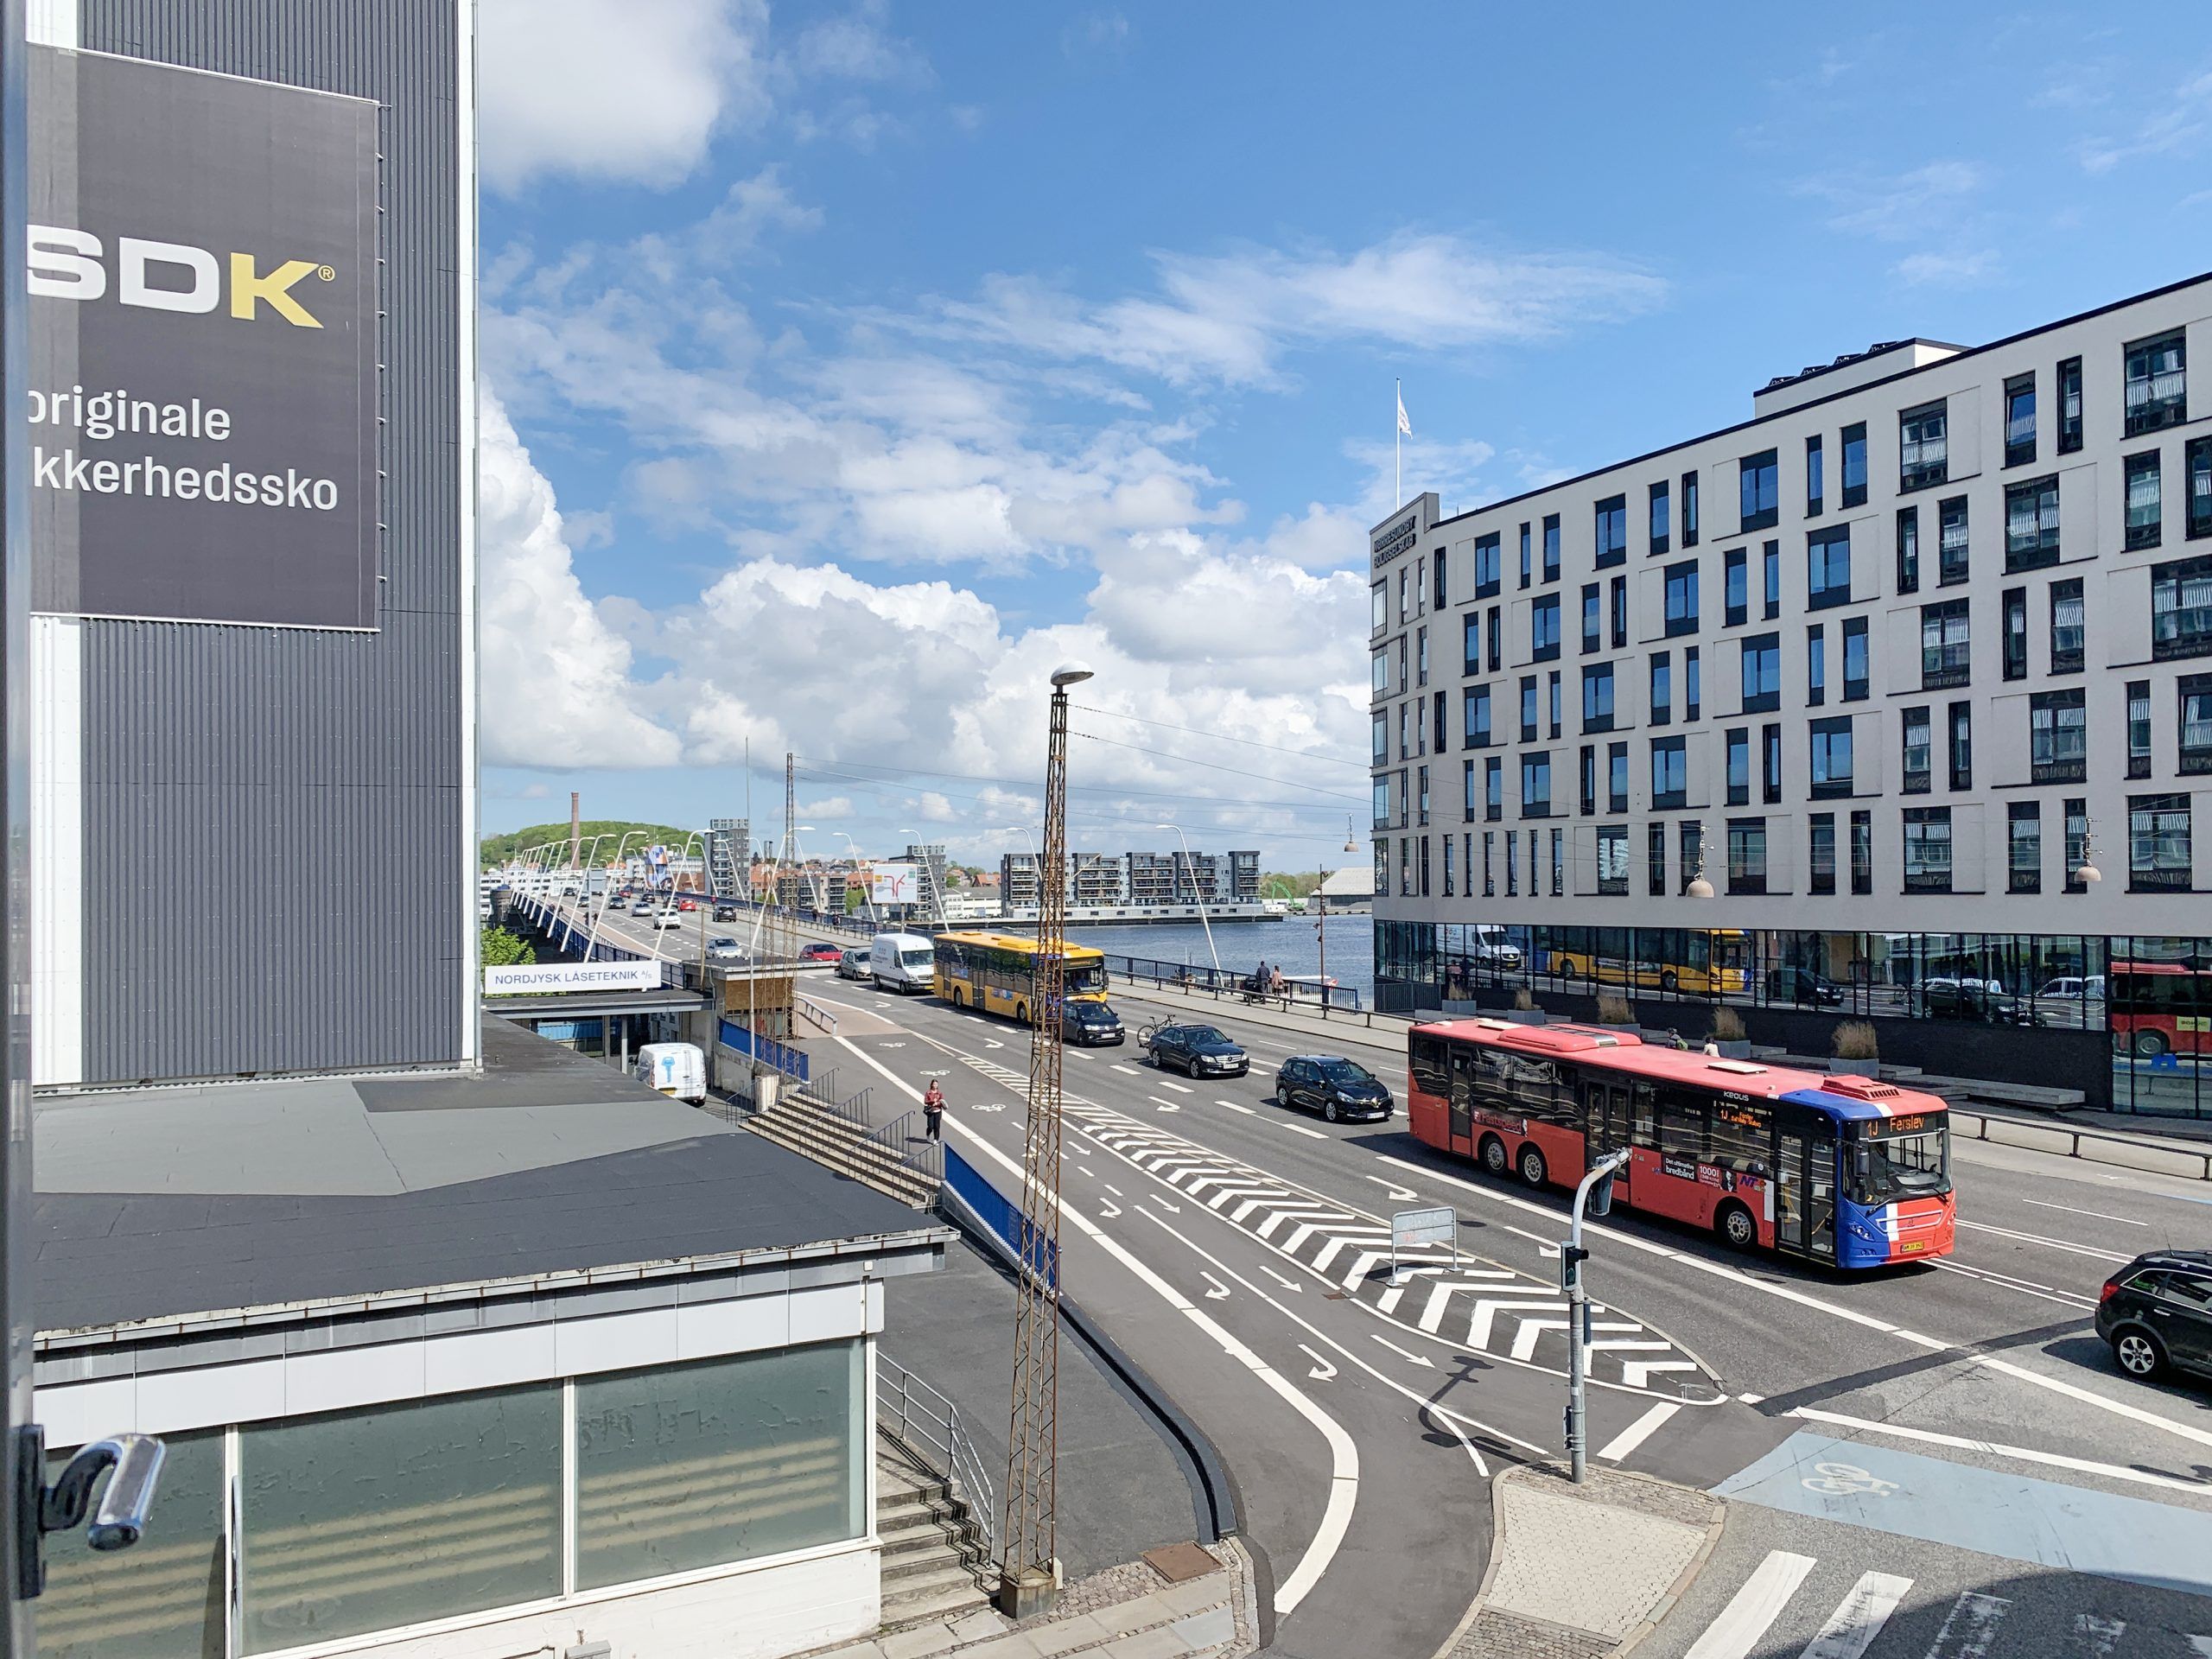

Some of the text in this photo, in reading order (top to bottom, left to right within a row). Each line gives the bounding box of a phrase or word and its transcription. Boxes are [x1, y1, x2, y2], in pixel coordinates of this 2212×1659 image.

[28, 385, 231, 441] originale
[495, 973, 562, 985] NORDJYSK
[564, 969, 638, 983] LÅSETEKNIK
[1867, 1115, 1925, 1136] 1J Ferslev
[1665, 1166, 1694, 1180] bredbånd
